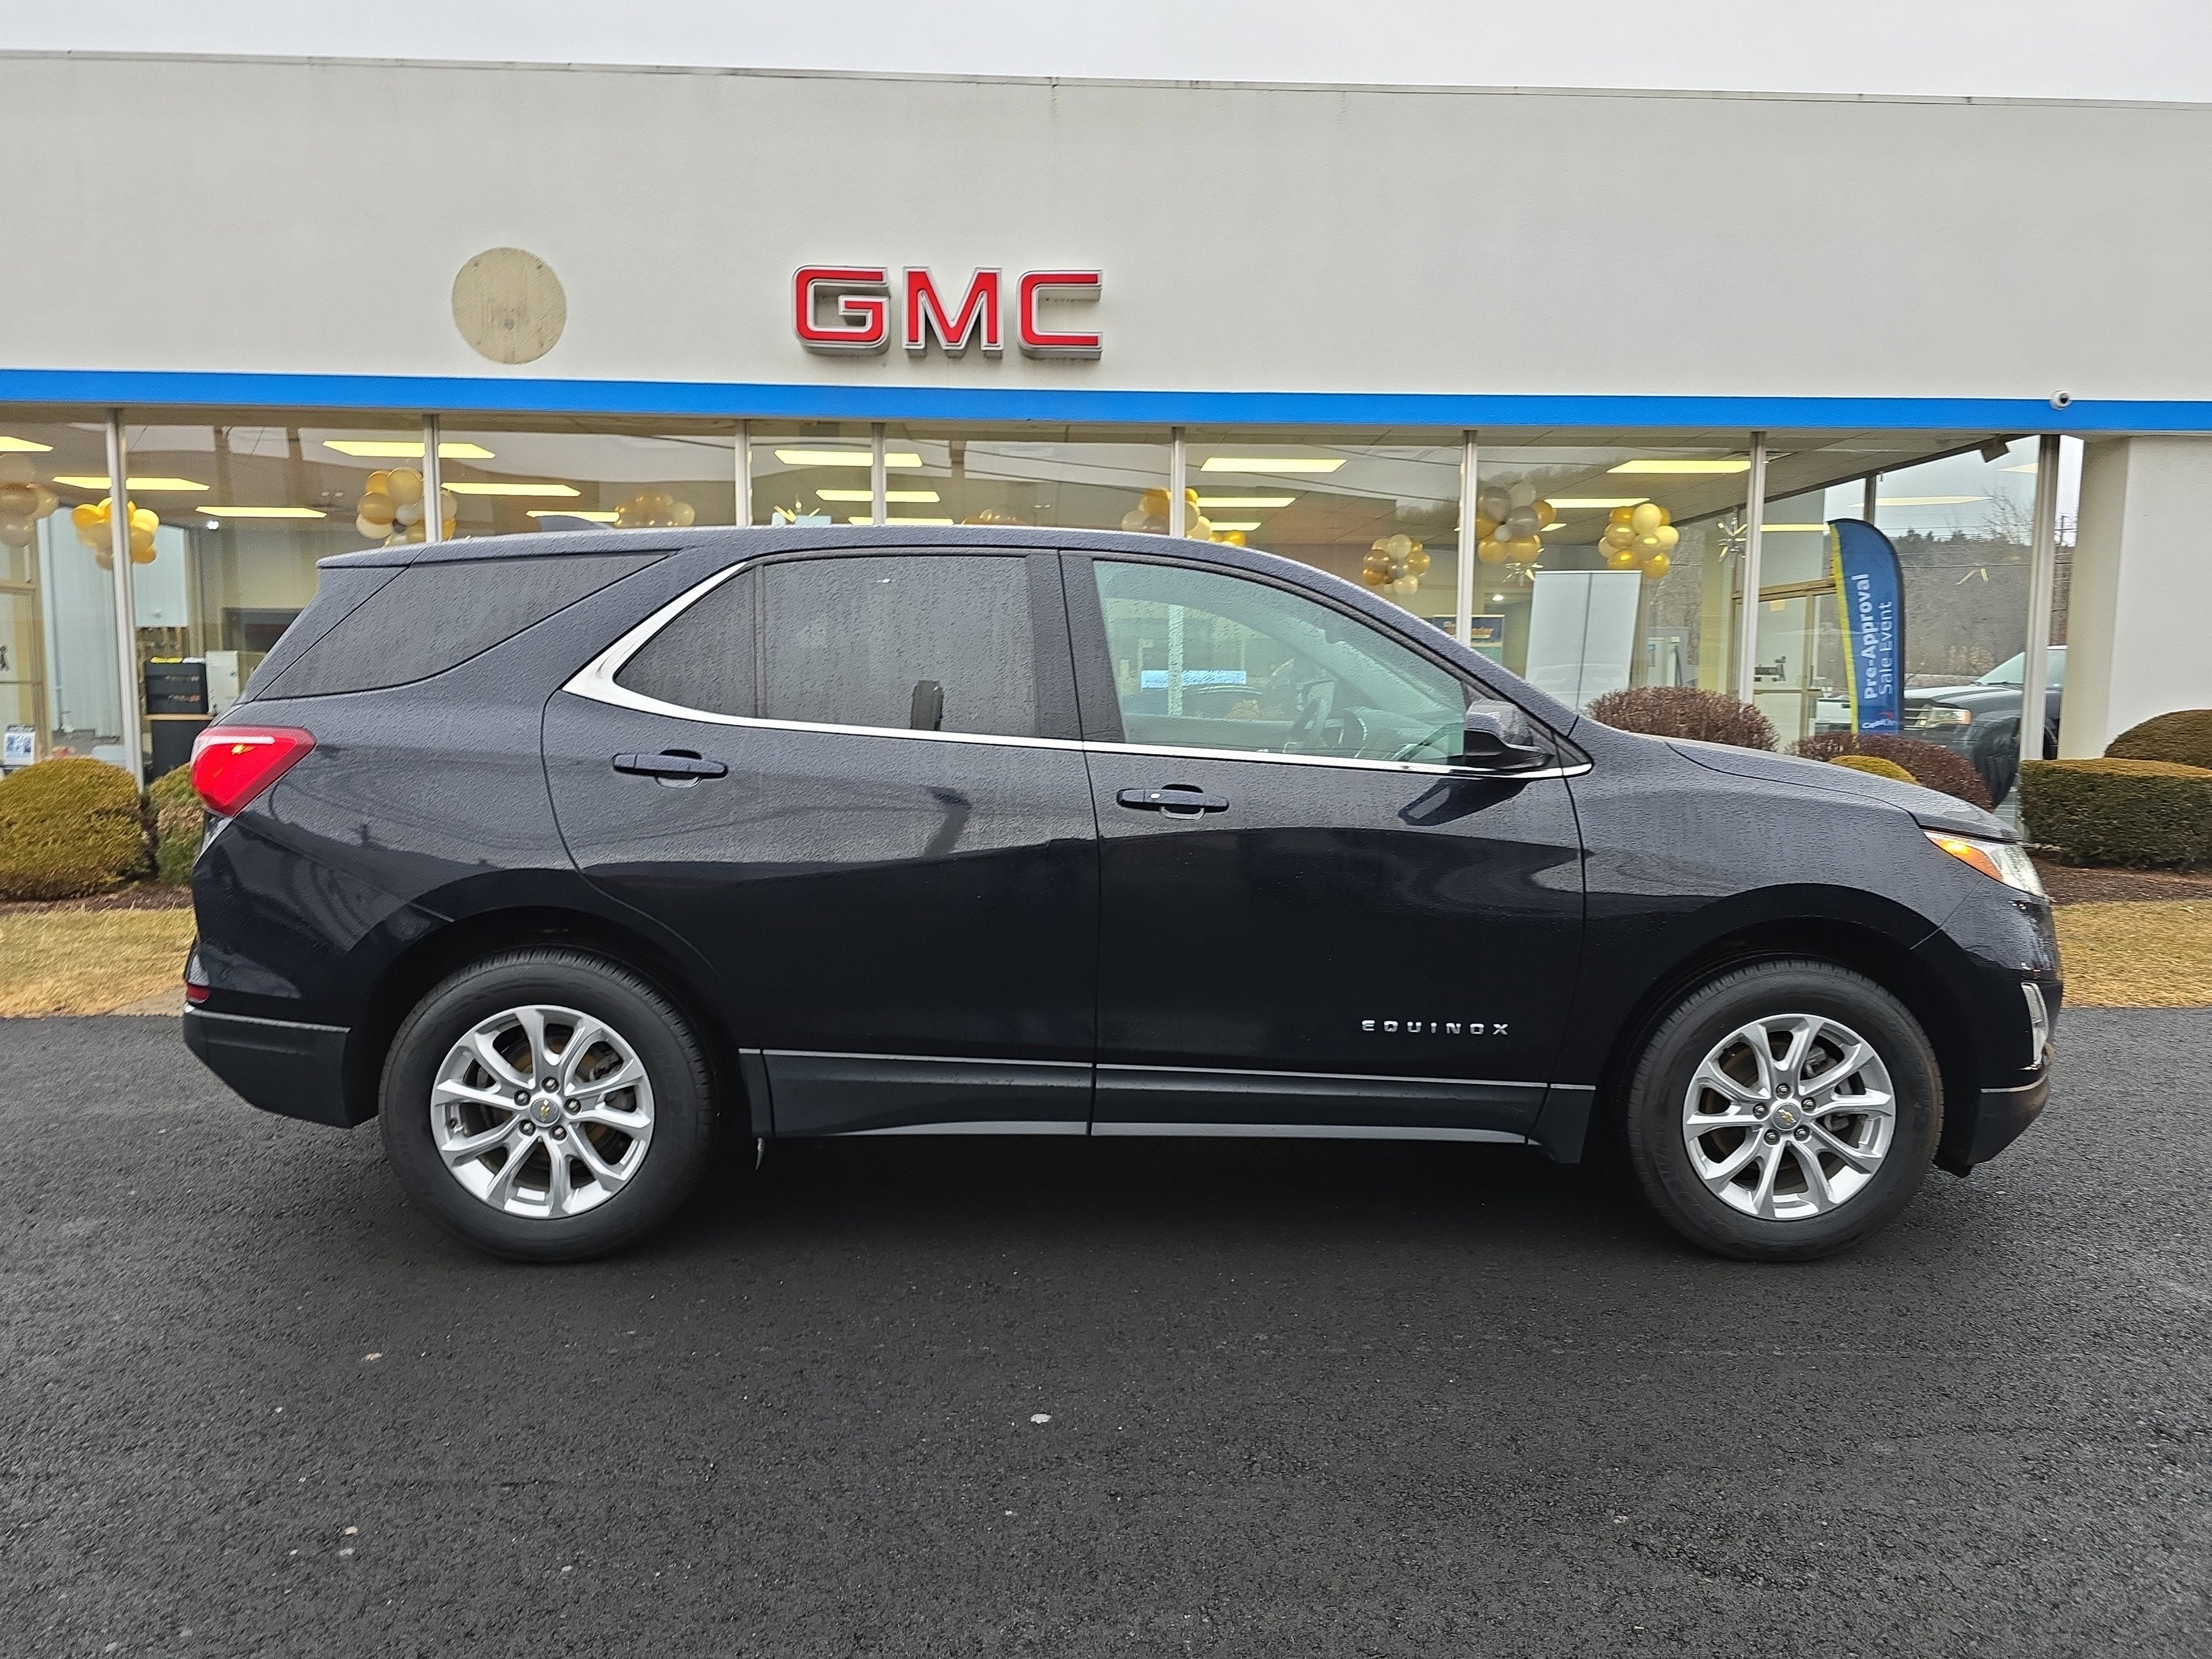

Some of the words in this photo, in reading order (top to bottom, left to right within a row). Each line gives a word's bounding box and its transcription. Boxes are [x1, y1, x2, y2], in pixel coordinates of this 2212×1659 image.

[792, 265, 1103, 356] GMC
[1850, 574, 1879, 699] Pre-Approval
[1878, 601, 1893, 652] Event
[1879, 657, 1893, 695] Sale
[1362, 1020, 1508, 1035] EQUINOX
